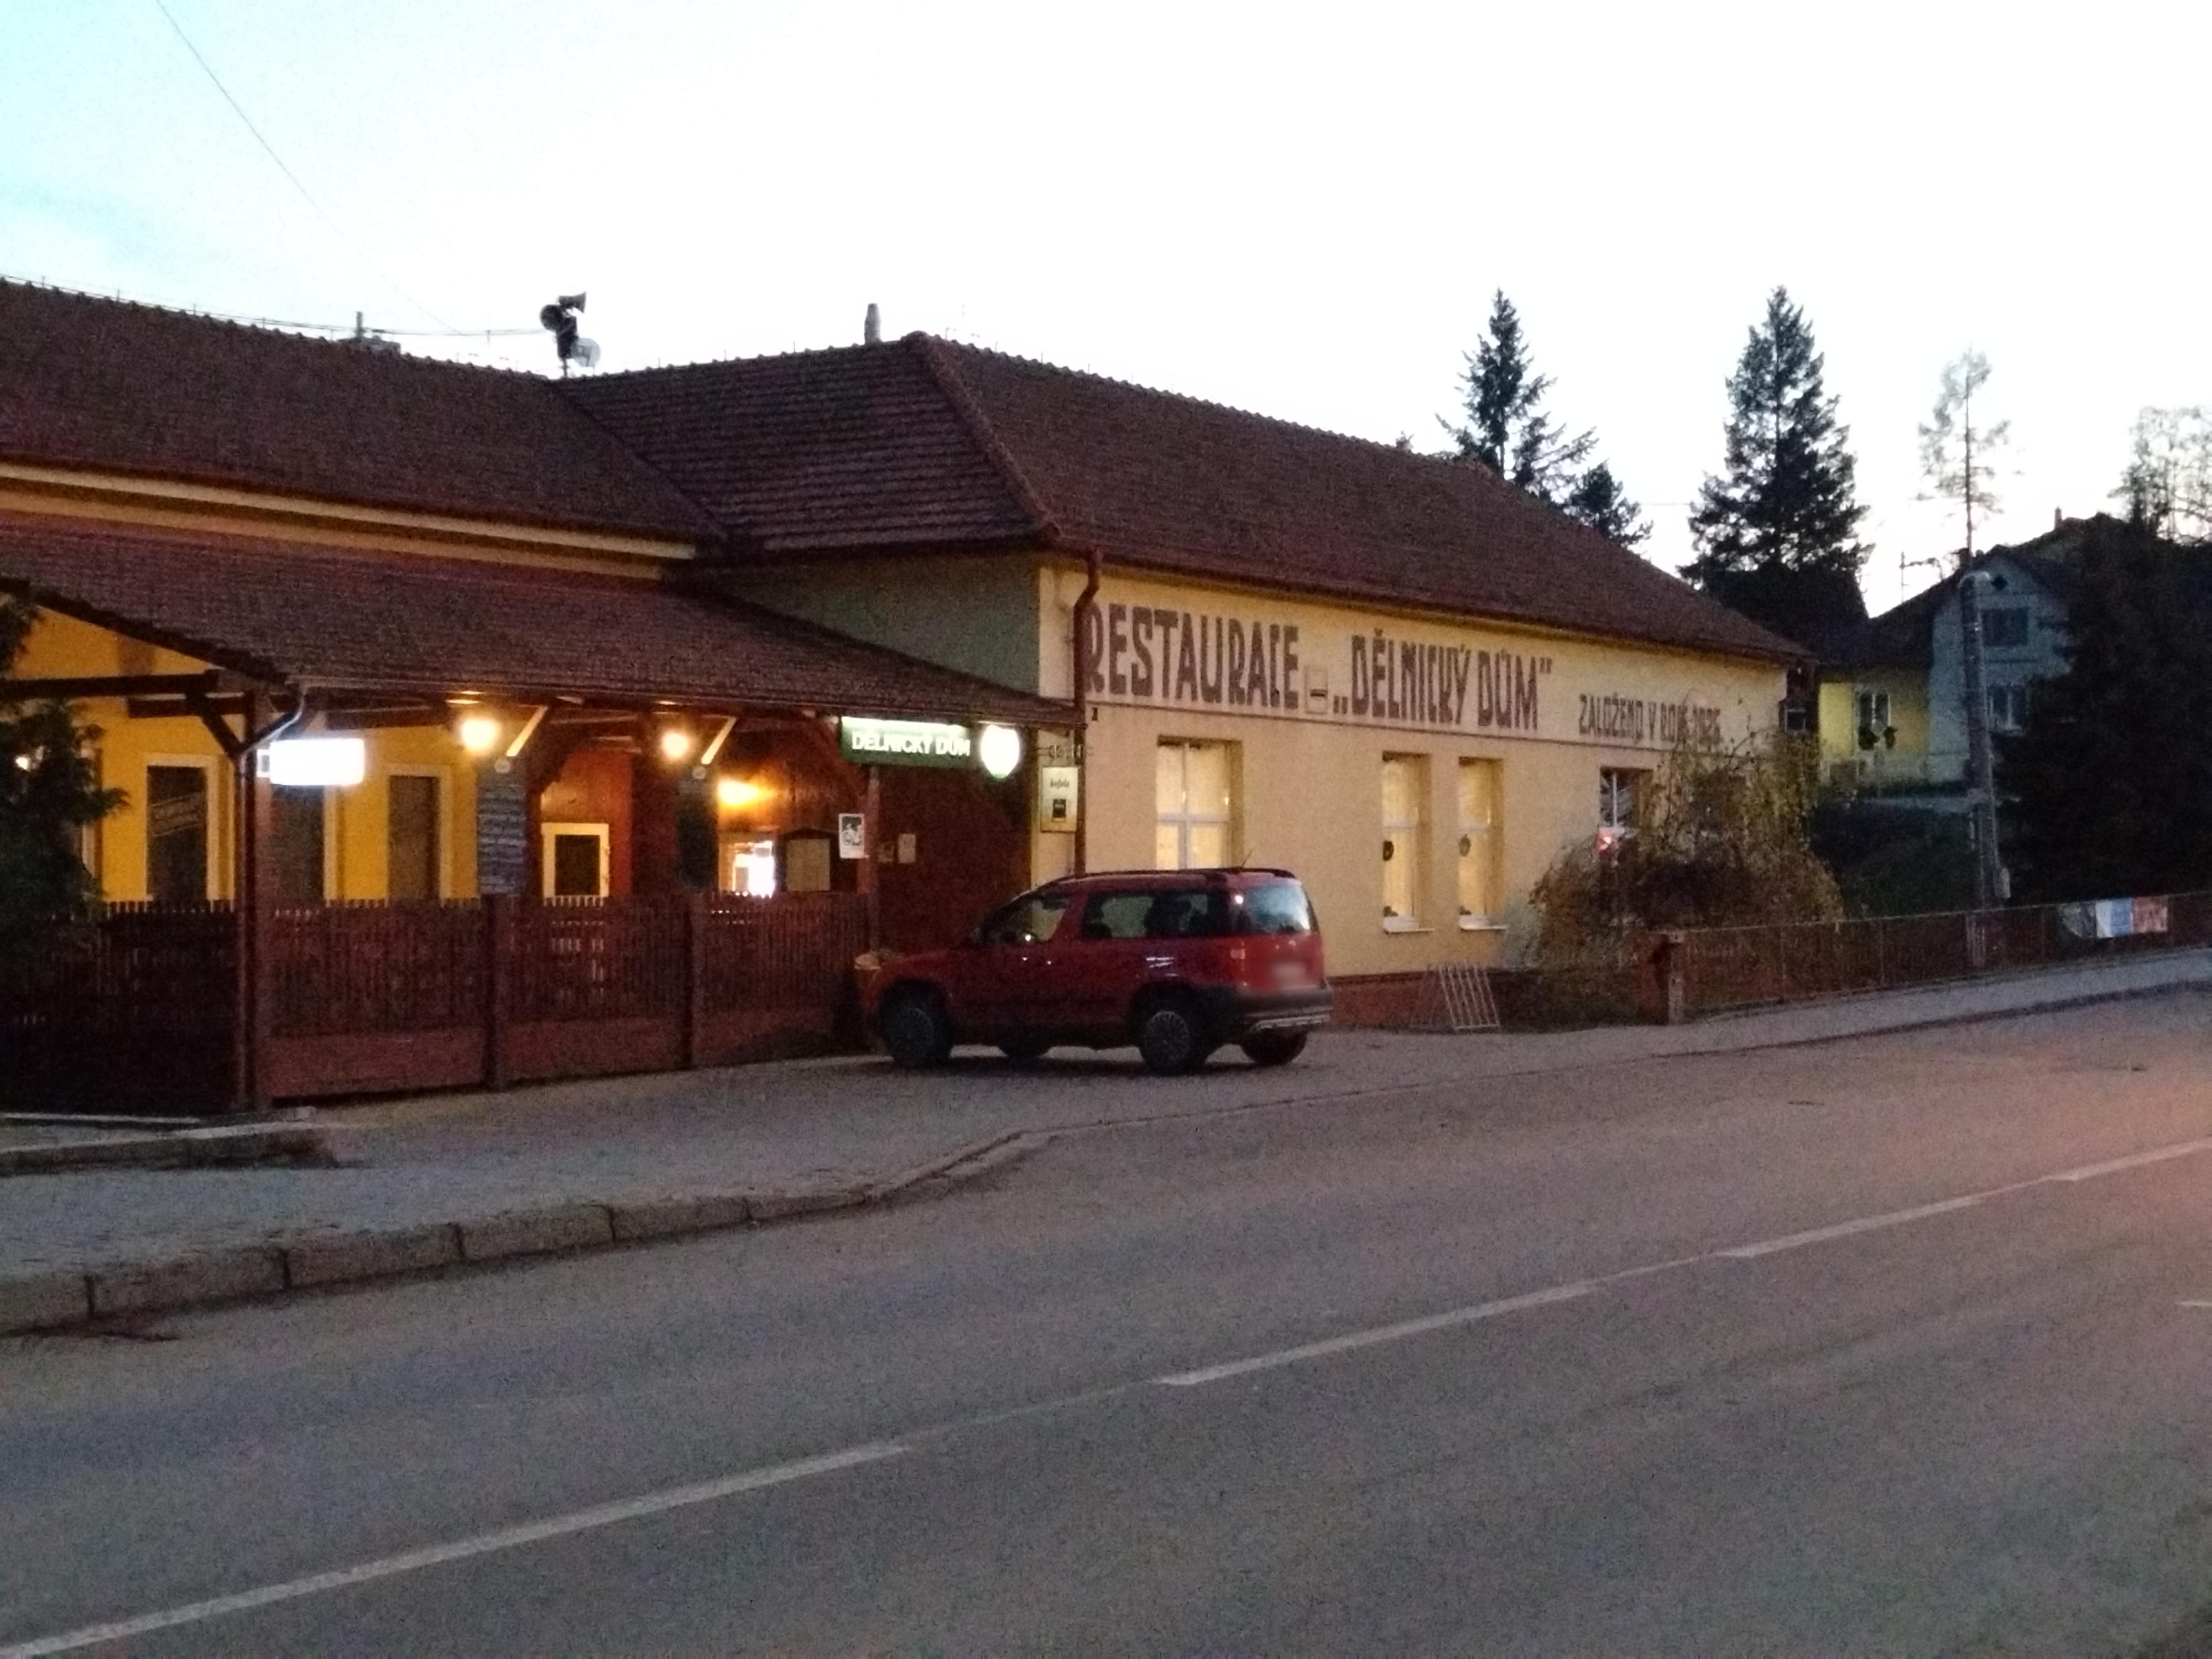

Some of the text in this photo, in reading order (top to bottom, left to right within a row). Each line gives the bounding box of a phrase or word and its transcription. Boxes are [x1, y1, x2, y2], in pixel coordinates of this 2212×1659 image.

[1084, 602, 1299, 709] RESTAURACE
[1579, 692, 1644, 740] ZALOŽENO
[1648, 701, 1657, 740] V
